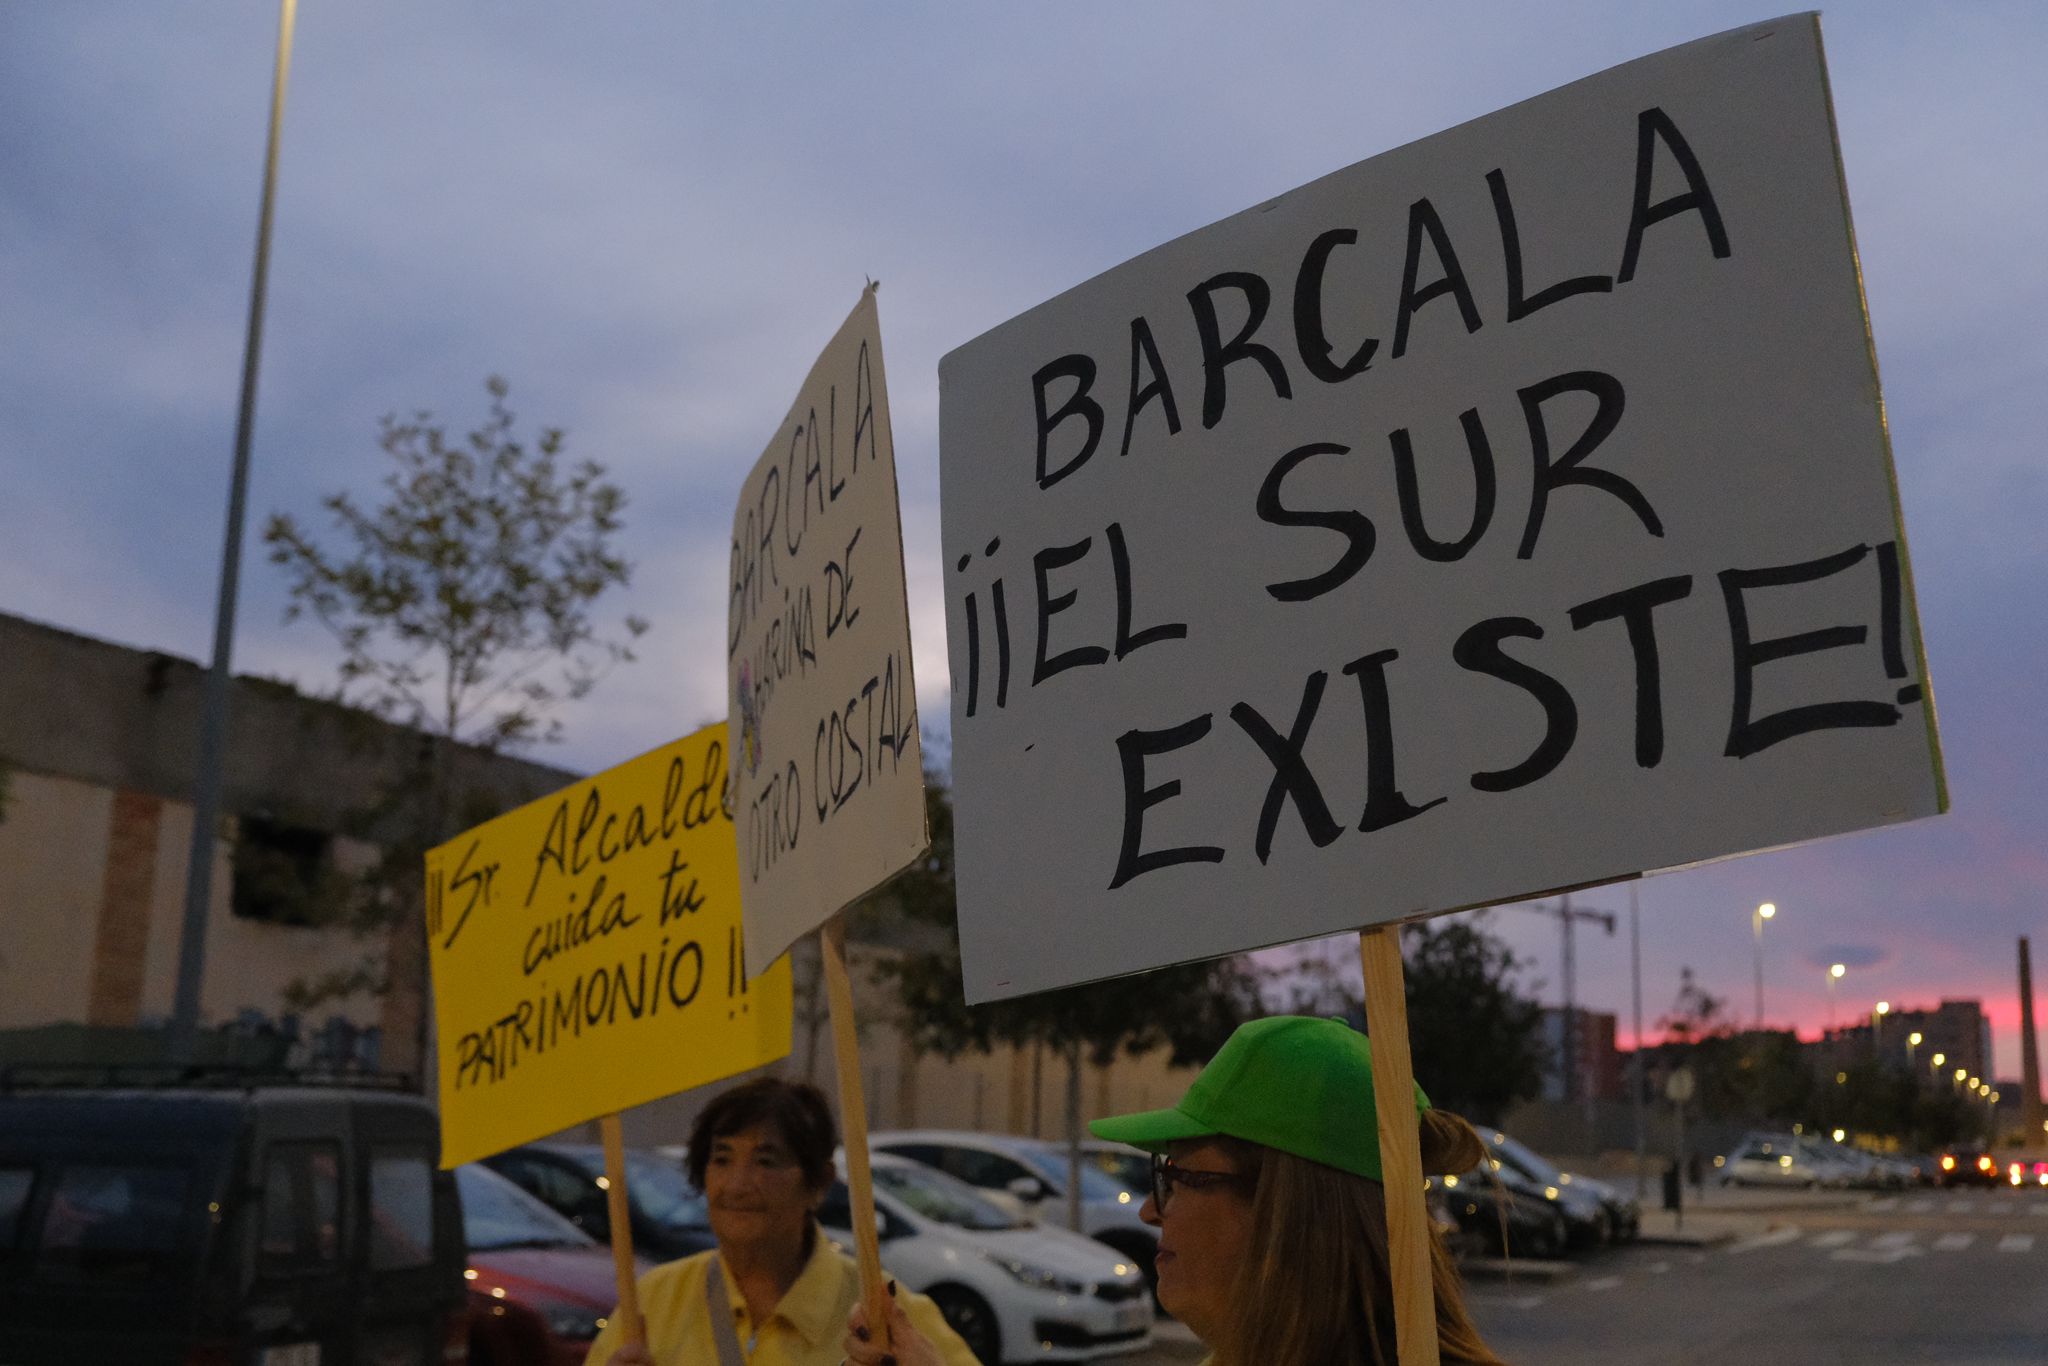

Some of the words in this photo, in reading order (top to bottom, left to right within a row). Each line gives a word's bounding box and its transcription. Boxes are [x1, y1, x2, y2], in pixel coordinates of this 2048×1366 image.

[1031, 105, 1732, 490] BARCALA
[729, 337, 876, 658] BARCALA
[822, 526, 862, 640] DE
[1254, 370, 1665, 602] SUR
[749, 760, 800, 884] OTRO
[814, 650, 917, 824] COSTAL
[1107, 541, 1924, 890] EXISTE!
[522, 874, 642, 977] cuida
[658, 848, 706, 929] tu
